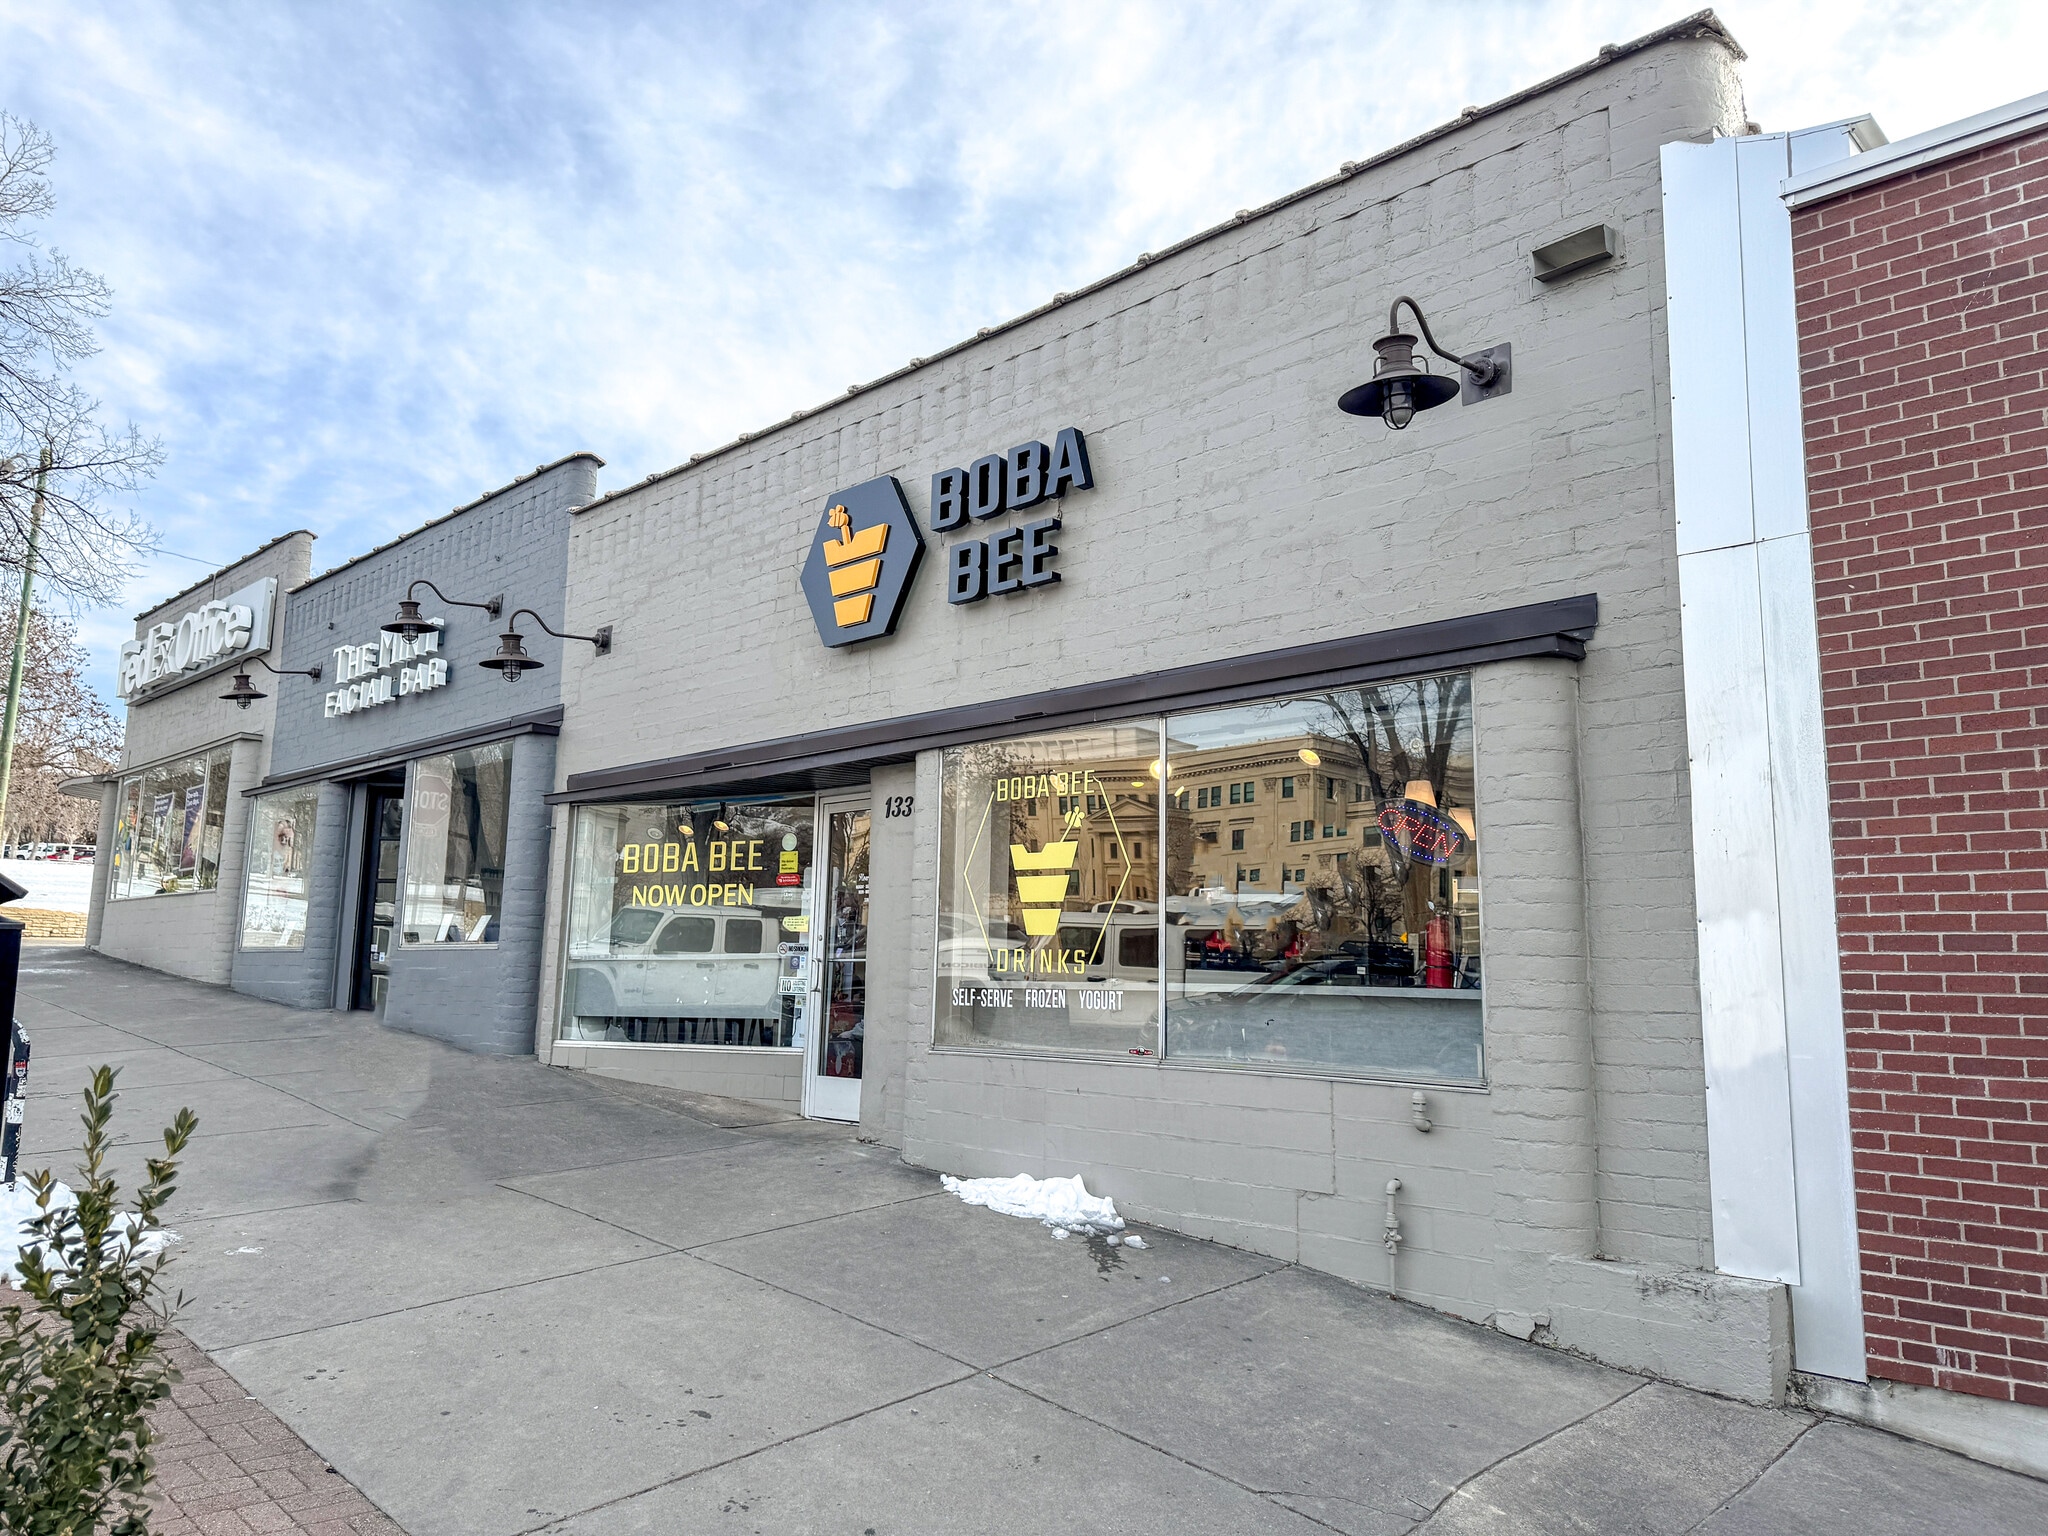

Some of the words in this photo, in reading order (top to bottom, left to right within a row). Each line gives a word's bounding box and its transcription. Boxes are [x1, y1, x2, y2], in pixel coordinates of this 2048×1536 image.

[930, 427, 1094, 533] BOBA
[948, 518, 1062, 605] BEE
[333, 642, 379, 684] THE
[324, 675, 396, 718] FACIAL
[399, 658, 448, 697] BAR
[997, 774, 1050, 801] BOBA
[1056, 769, 1095, 796] BEE
[885, 796, 914, 818] 133
[1377, 808, 1460, 858] OPEN
[622, 842, 699, 873] BOBA
[708, 840, 764, 872] BEE
[632, 884, 685, 907] NOW
[690, 883, 754, 907] OPEN
[996, 948, 1086, 974] DRINKS
[952, 987, 1013, 1008] SELF-SERVE
[1025, 988, 1066, 1009] FROZEN
[1078, 989, 1124, 1010] YOGURT
